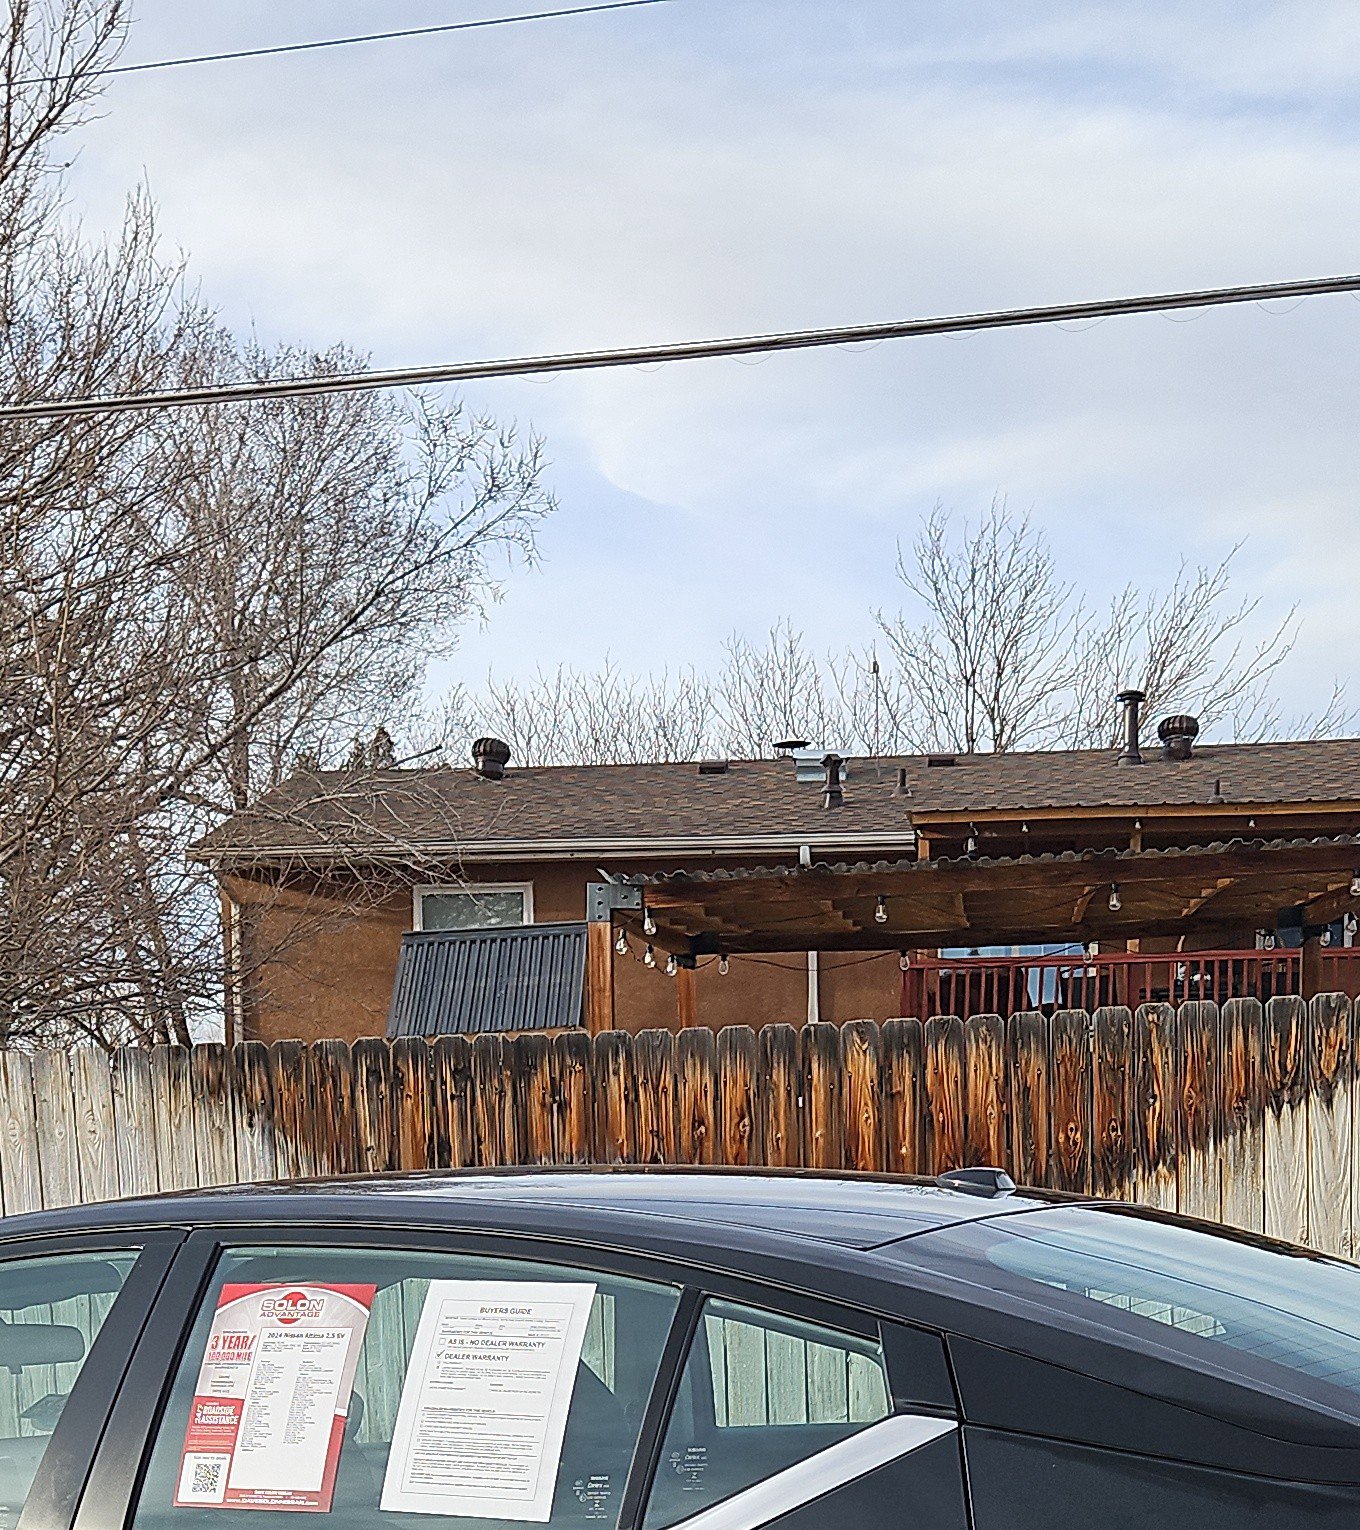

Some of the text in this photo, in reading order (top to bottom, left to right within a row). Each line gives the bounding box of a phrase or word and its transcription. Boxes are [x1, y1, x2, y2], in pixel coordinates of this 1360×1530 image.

[261, 1299, 325, 1311] SOLON
[509, 1307, 533, 1315] GUIDE
[211, 1335, 219, 1350] 3
[221, 1334, 257, 1350] YEAR/
